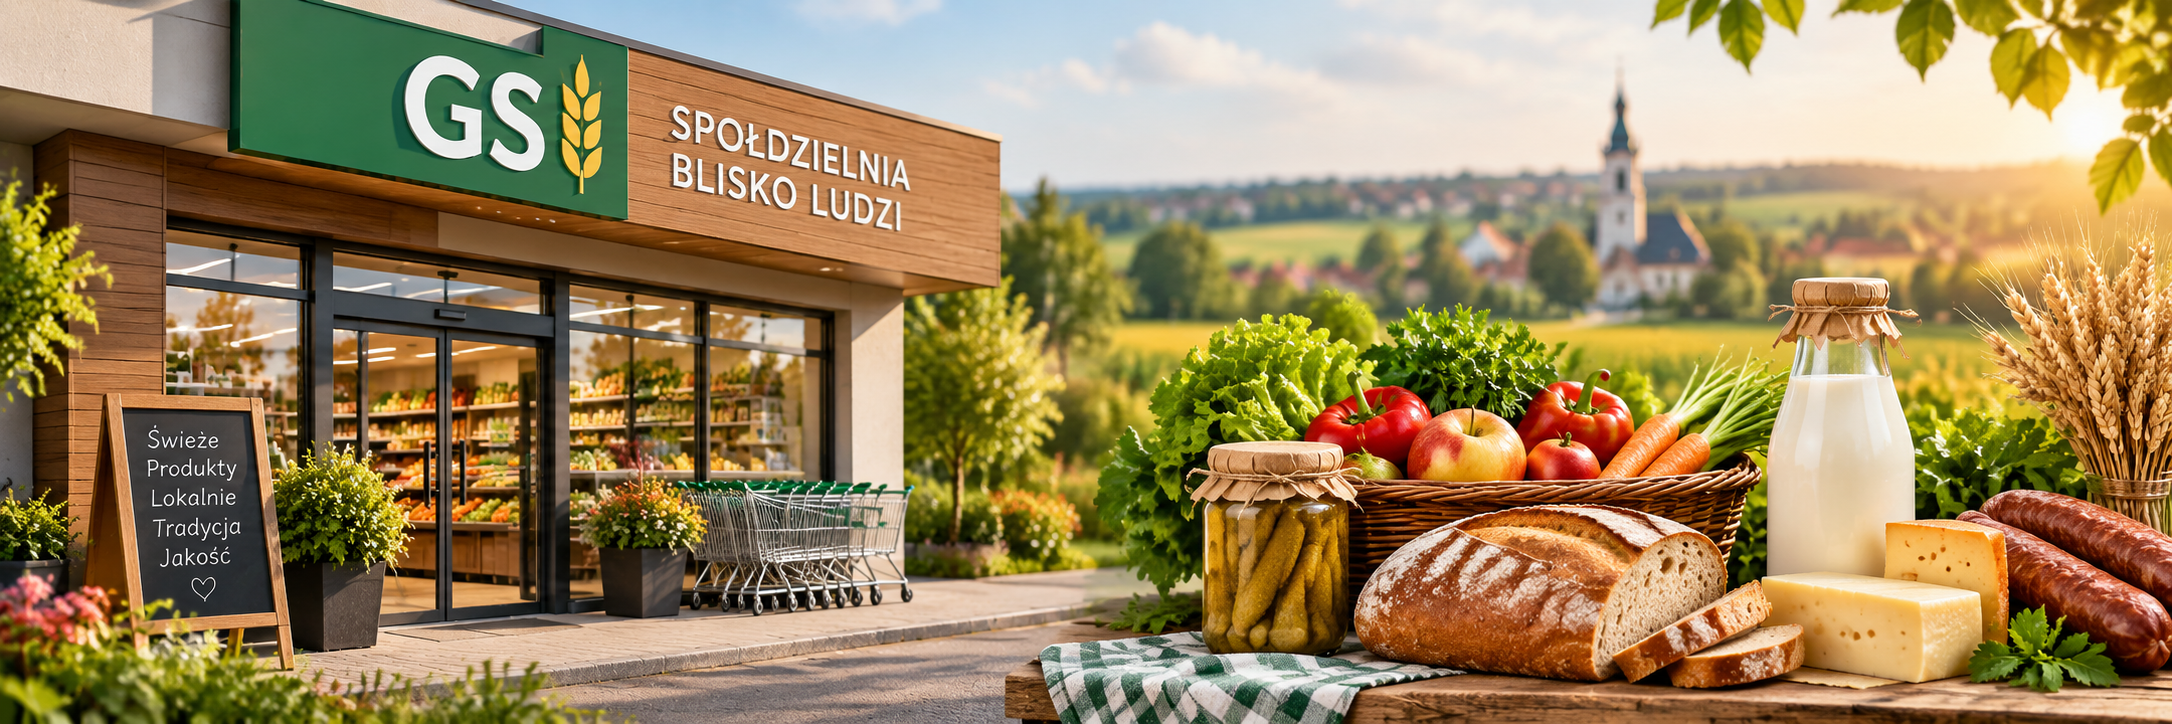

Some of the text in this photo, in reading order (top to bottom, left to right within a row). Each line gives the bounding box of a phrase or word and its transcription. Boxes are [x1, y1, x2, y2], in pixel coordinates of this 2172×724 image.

[404, 55, 545, 172] GS
[671, 105, 911, 191] SPOŁDZIELNIA
[672, 153, 902, 231] BLISKO LUDZI
[147, 424, 219, 449] Świeże
[147, 458, 237, 481] Produkty
[151, 487, 236, 507] Lokalnie
[152, 517, 241, 541] Tradycja
[159, 546, 231, 567] Jakość
